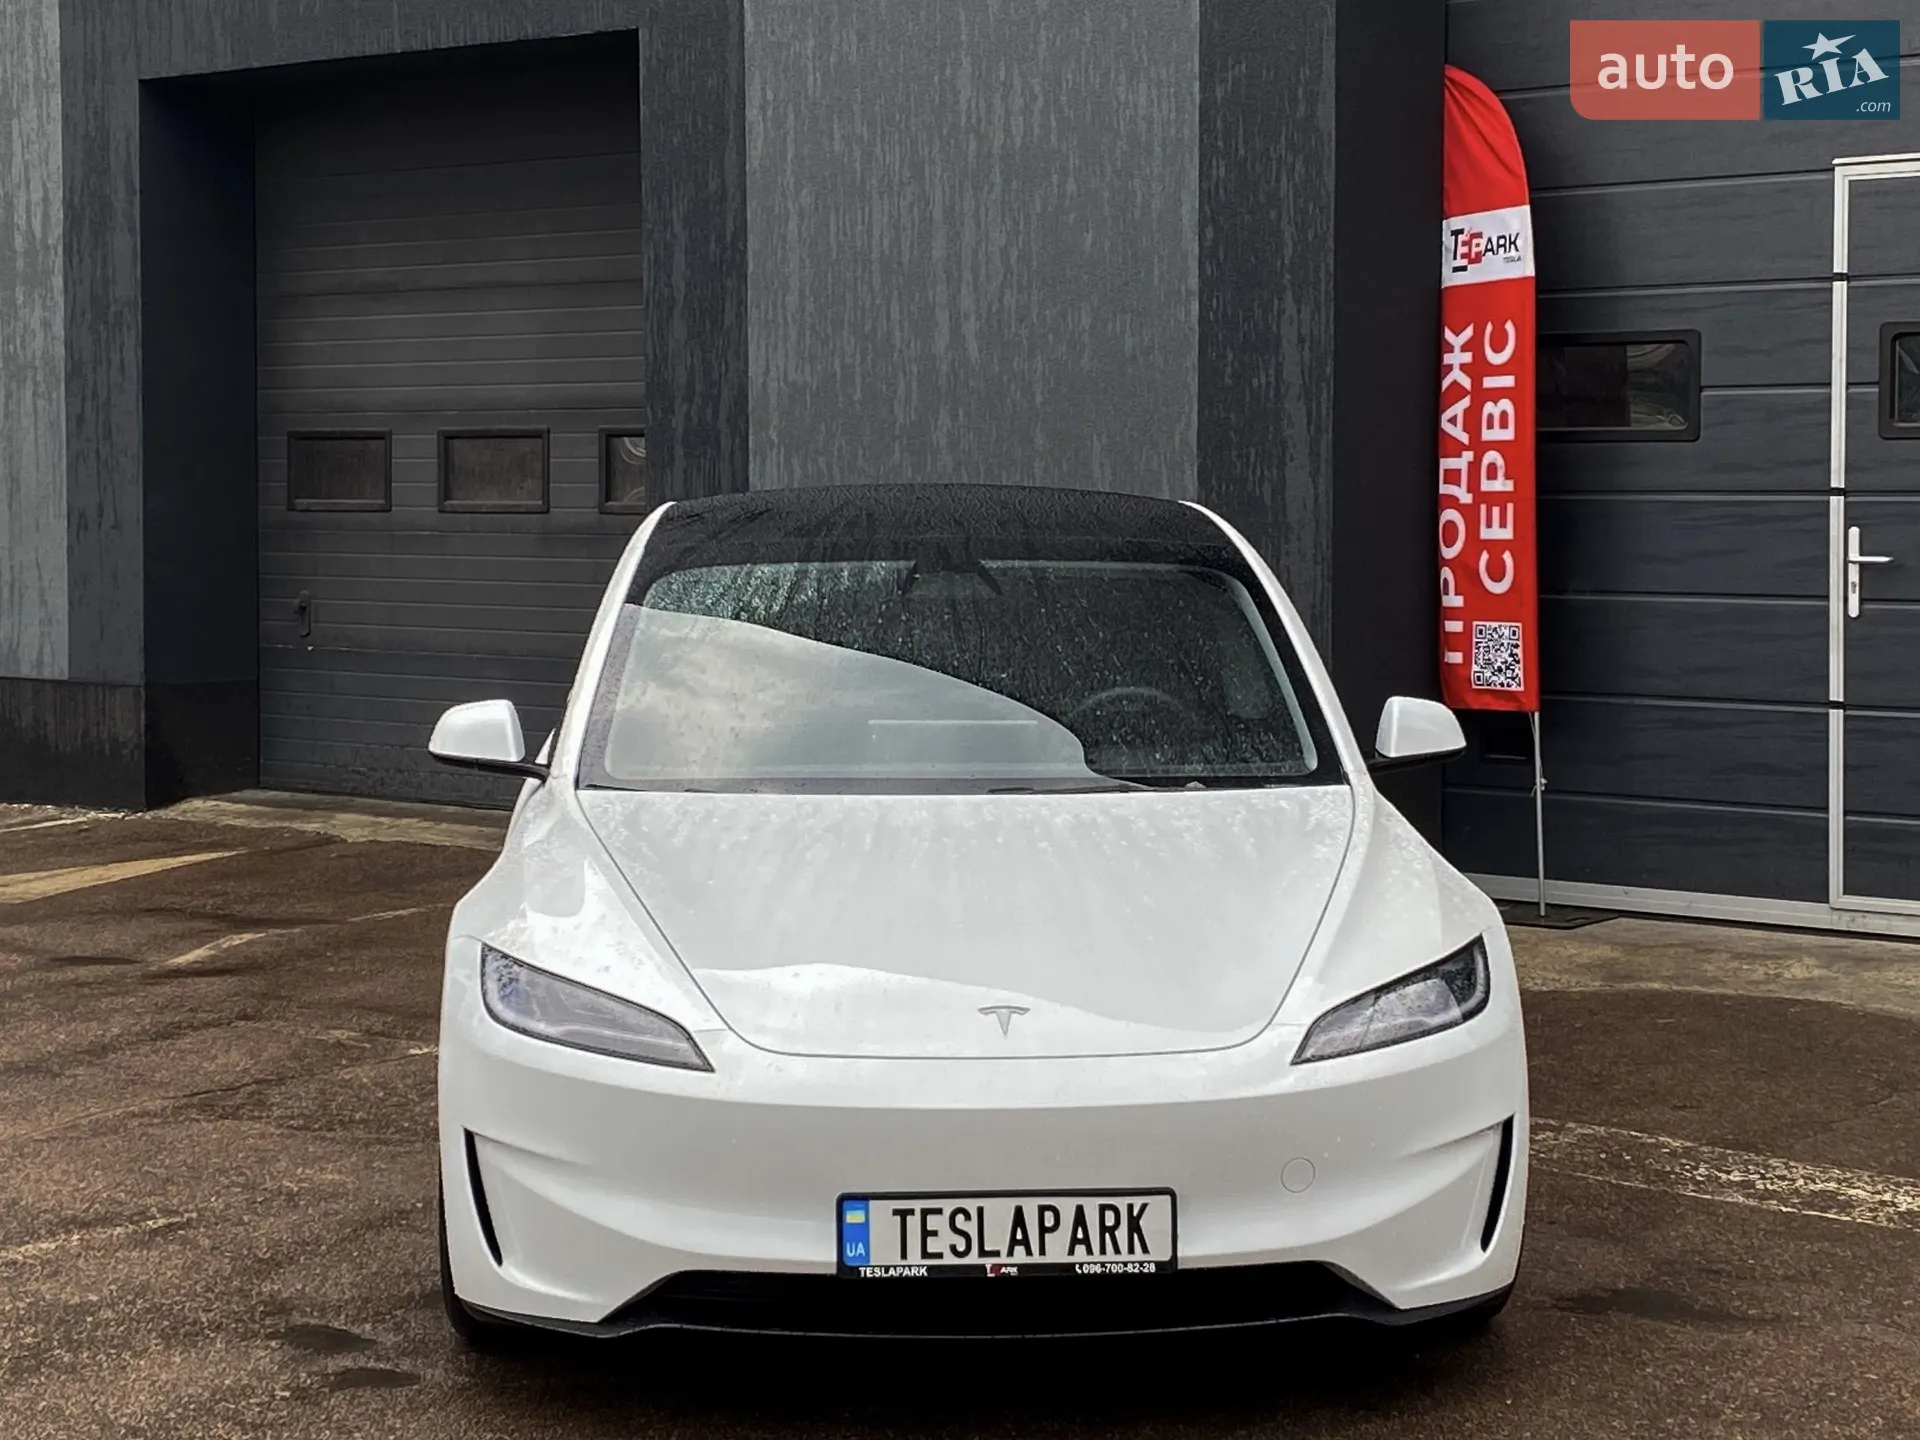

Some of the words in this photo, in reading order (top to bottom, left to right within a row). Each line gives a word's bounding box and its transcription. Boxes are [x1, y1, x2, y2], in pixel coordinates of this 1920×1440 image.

[1479, 319, 1516, 595] СЕРВІС
[846, 1242, 866, 1257] UA
[892, 1202, 1150, 1261] TESLAPARK
[859, 1266, 928, 1278] TESLAPARK
